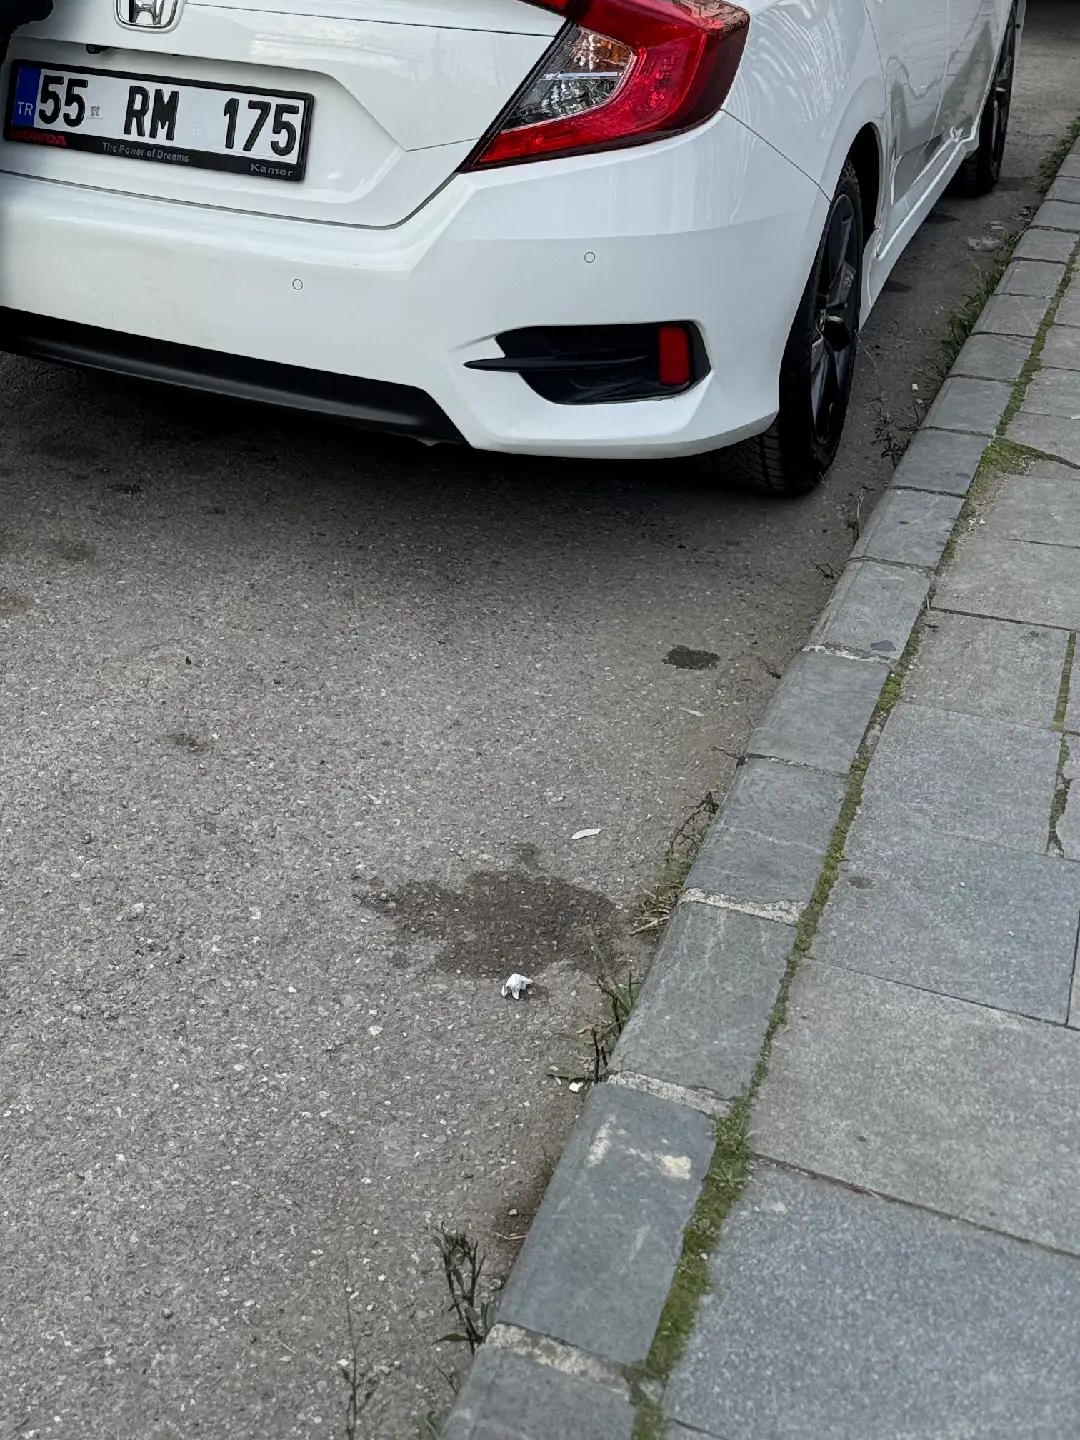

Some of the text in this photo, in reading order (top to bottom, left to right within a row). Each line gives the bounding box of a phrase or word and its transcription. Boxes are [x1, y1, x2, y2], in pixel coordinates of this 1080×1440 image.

[18, 101, 34, 117] TR
[38, 74, 299, 157] 55 RM 175
[119, 144, 145, 157] Power
[146, 147, 156, 158] of
[157, 149, 190, 163] Dreams
